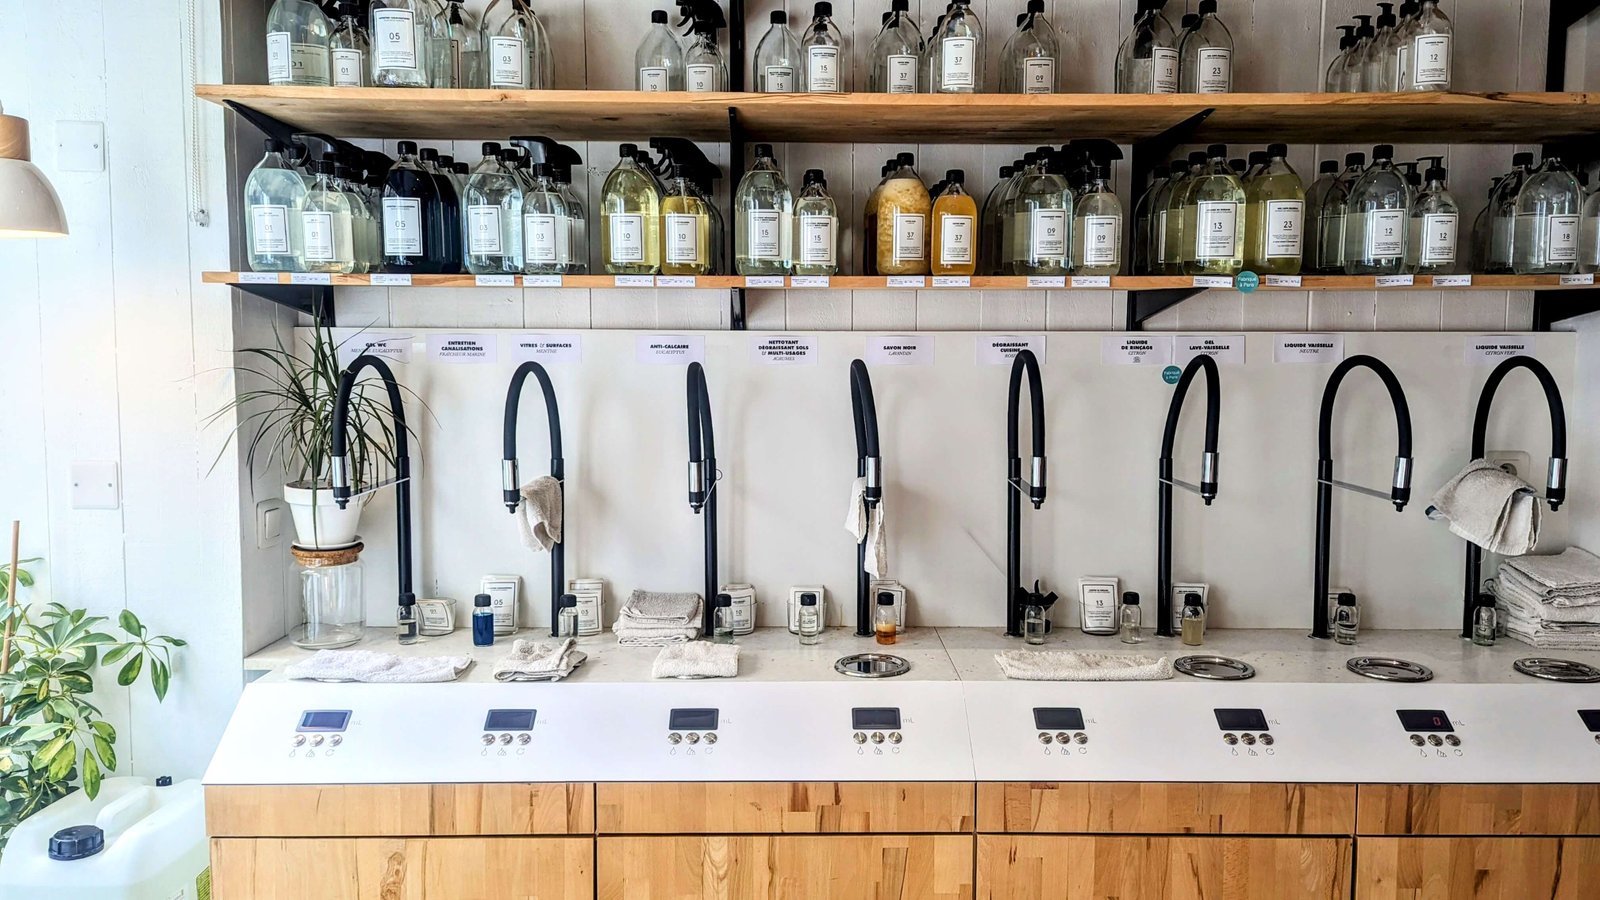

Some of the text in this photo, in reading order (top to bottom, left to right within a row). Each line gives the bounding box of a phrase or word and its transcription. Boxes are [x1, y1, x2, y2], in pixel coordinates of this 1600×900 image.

[389, 33, 401, 41] 05
[1212, 67, 1222, 75] 23
[395, 220, 406, 228] 05
[1213, 222, 1223, 230] 13
[535, 232, 544, 240] 03
[1096, 599, 1104, 607] 13
[1433, 717, 1441, 726] 0
